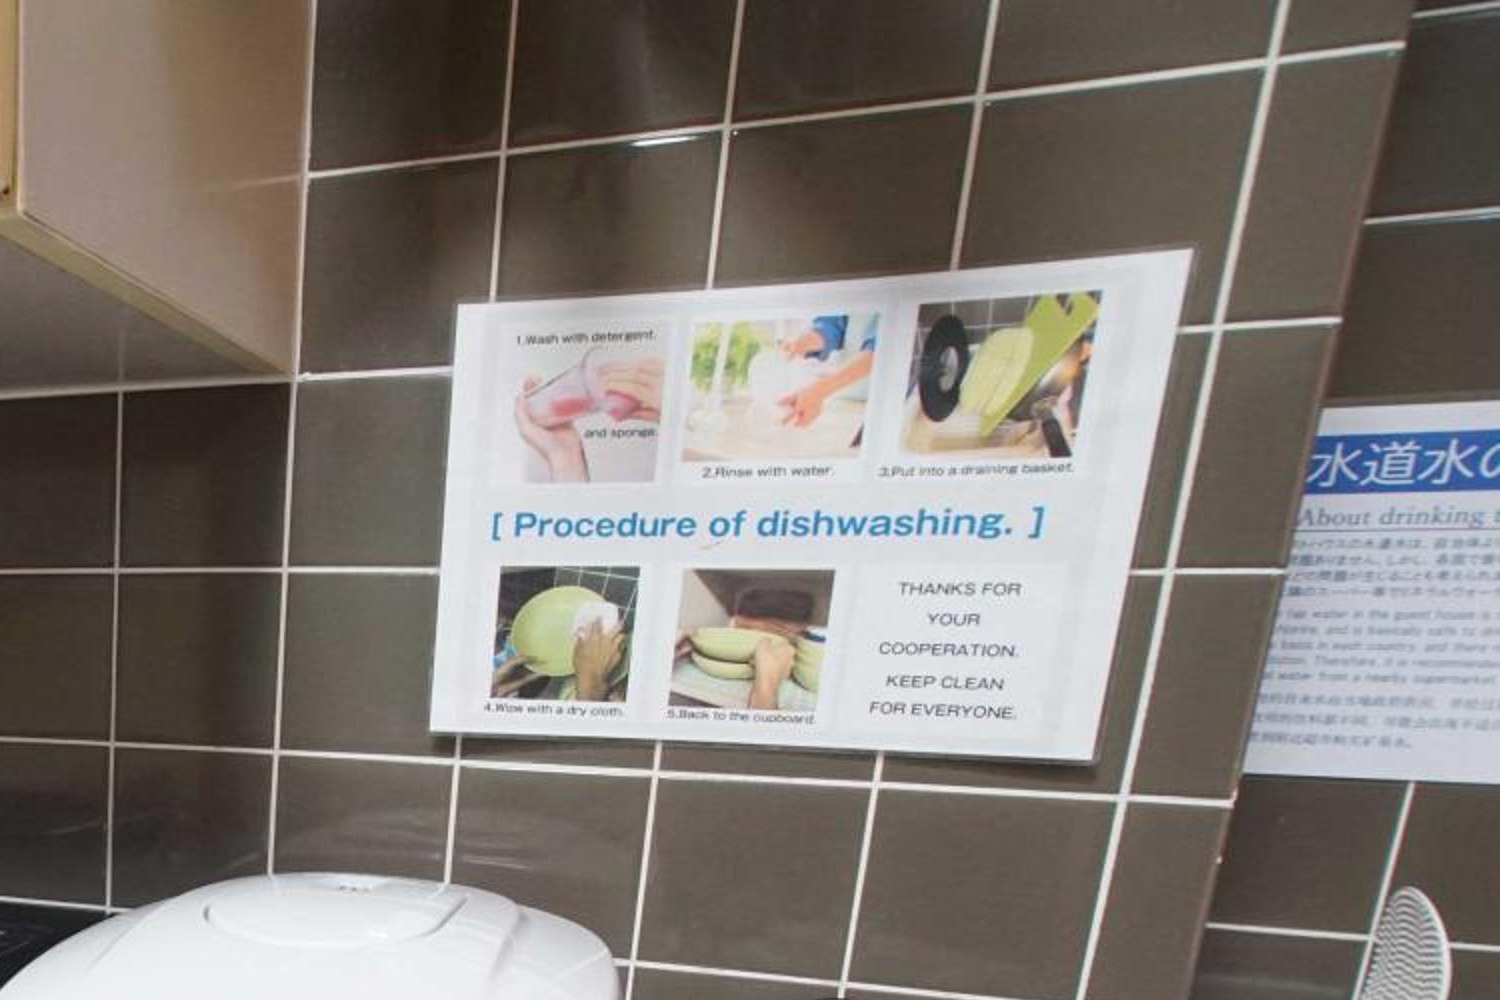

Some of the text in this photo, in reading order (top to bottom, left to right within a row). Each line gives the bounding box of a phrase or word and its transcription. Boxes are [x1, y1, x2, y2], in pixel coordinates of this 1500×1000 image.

[562, 333, 589, 344] with
[591, 330, 657, 343] detergent.
[584, 428, 607, 438] and
[757, 467, 787, 477] with
[919, 465, 945, 476] into
[961, 464, 1017, 476] draining
[1300, 504, 1485, 528] About drinking
[514, 512, 697, 537] Procedure
[709, 510, 747, 537] of
[757, 508, 1012, 539] dishwashing.
[900, 582, 1023, 596] THANKS FOR
[928, 613, 981, 626] YOUR
[878, 642, 1020, 657] COOPERATION.
[886, 675, 1005, 690] KEEP CLEAN
[527, 704, 552, 714] with
[567, 704, 586, 716] dry
[713, 711, 726, 720] to
[729, 711, 749, 721] the
[869, 701, 1017, 720] FOR EVERYONE.
